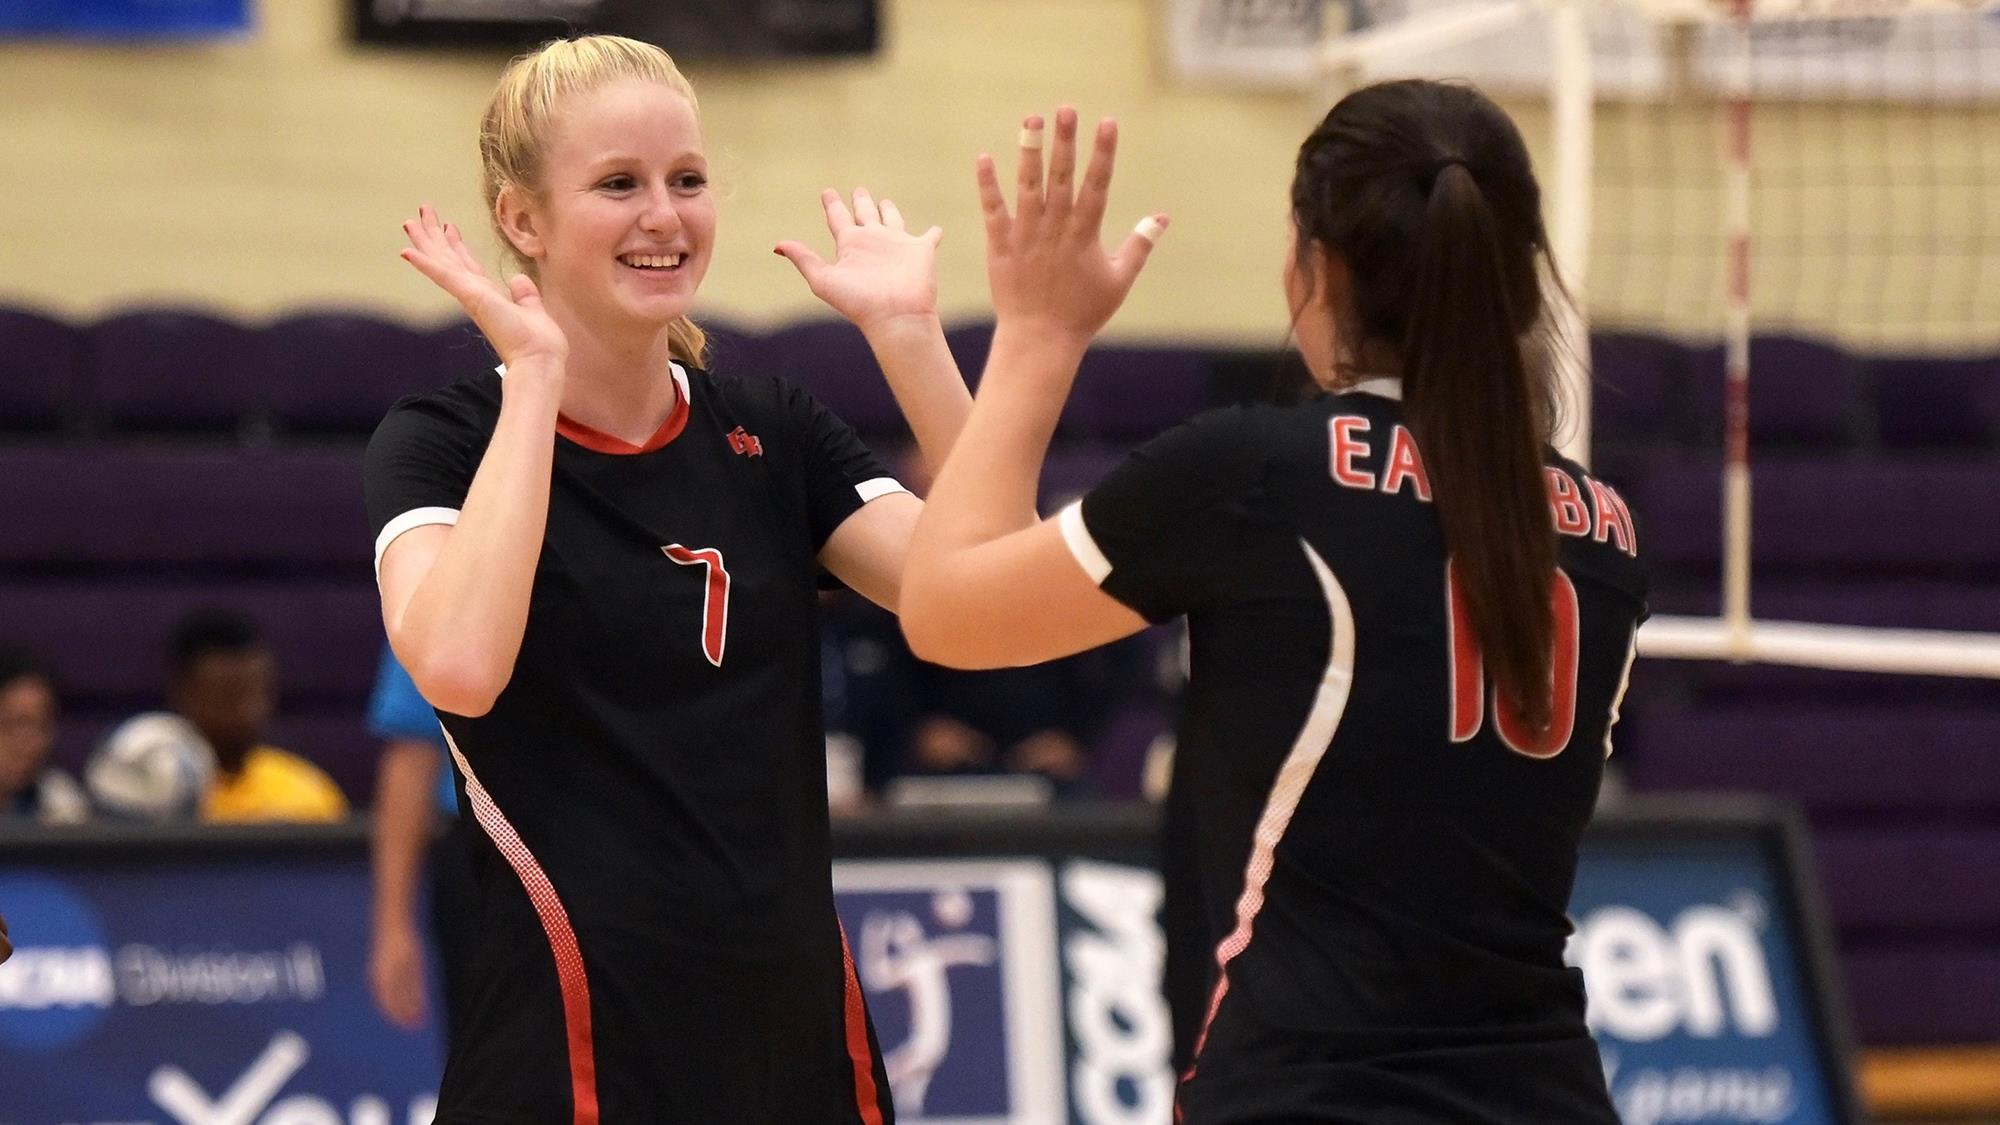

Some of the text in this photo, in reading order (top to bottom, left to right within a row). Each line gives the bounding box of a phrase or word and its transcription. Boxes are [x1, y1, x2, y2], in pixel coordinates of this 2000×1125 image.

[1329, 414, 1433, 502] EA
[660, 543, 731, 668] 7
[1562, 904, 1779, 1042] en
